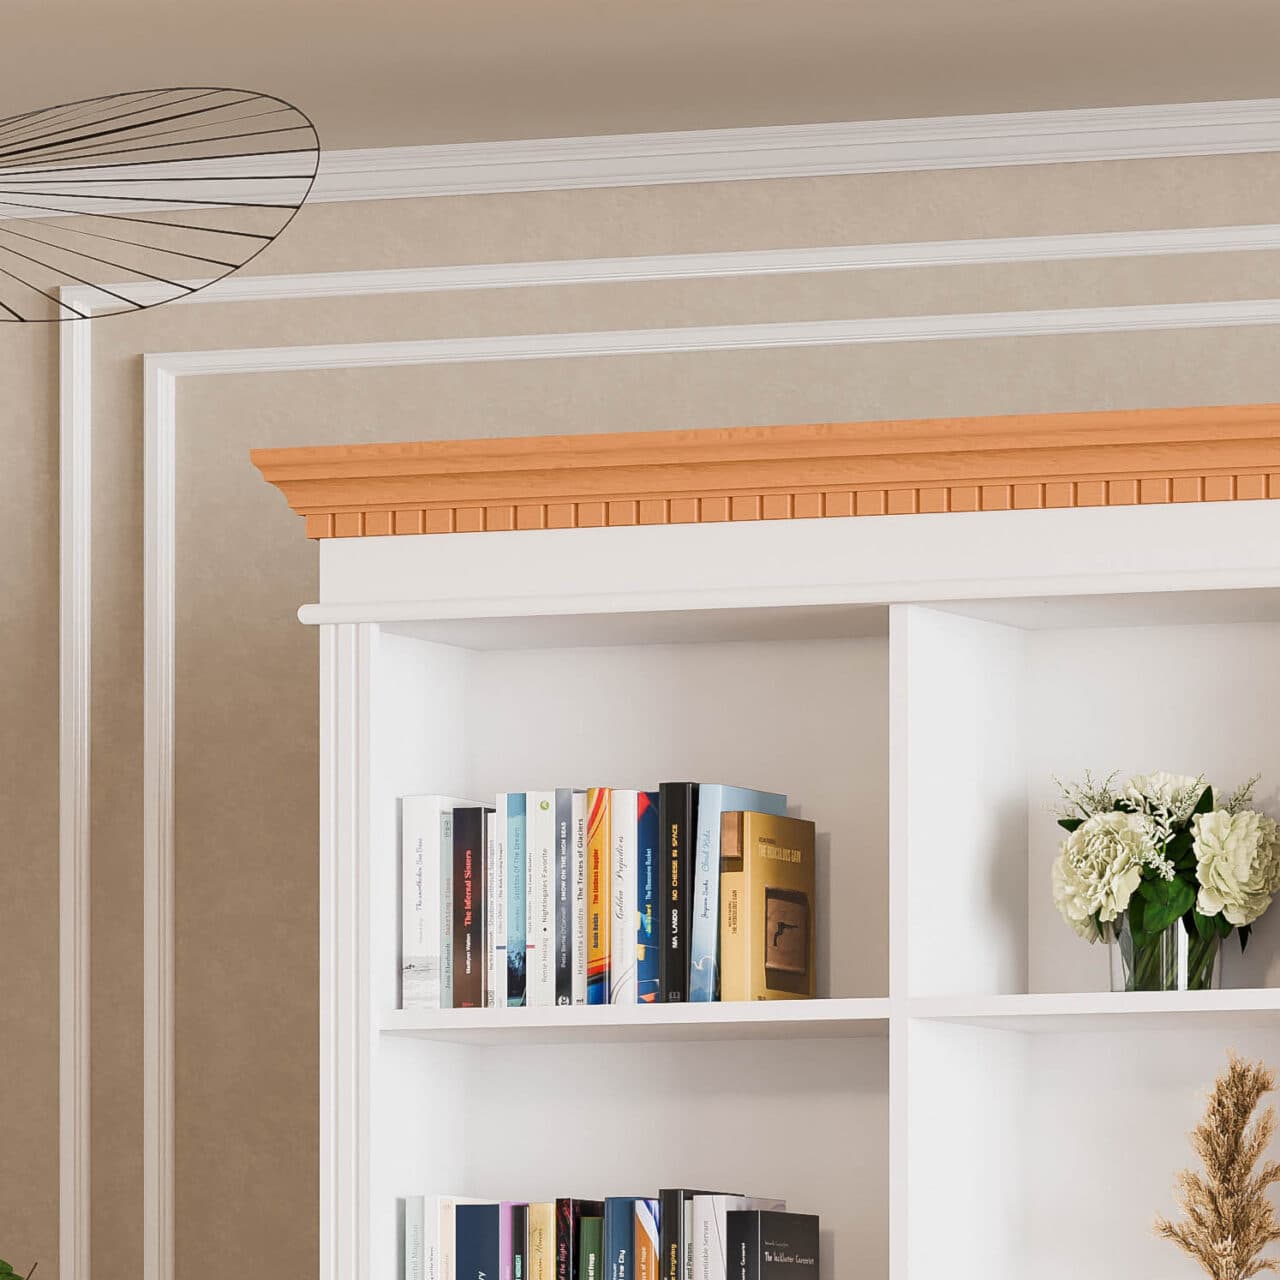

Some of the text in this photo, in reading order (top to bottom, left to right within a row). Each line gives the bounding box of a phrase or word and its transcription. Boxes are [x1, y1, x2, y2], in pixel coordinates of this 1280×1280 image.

[576, 818, 584, 900] The Traces of Glaciers
[464, 849, 472, 927] The Infernal Sisters
[671, 890, 678, 900] NO
[618, 1250, 626, 1264] City
[618, 1265, 626, 1278] the
